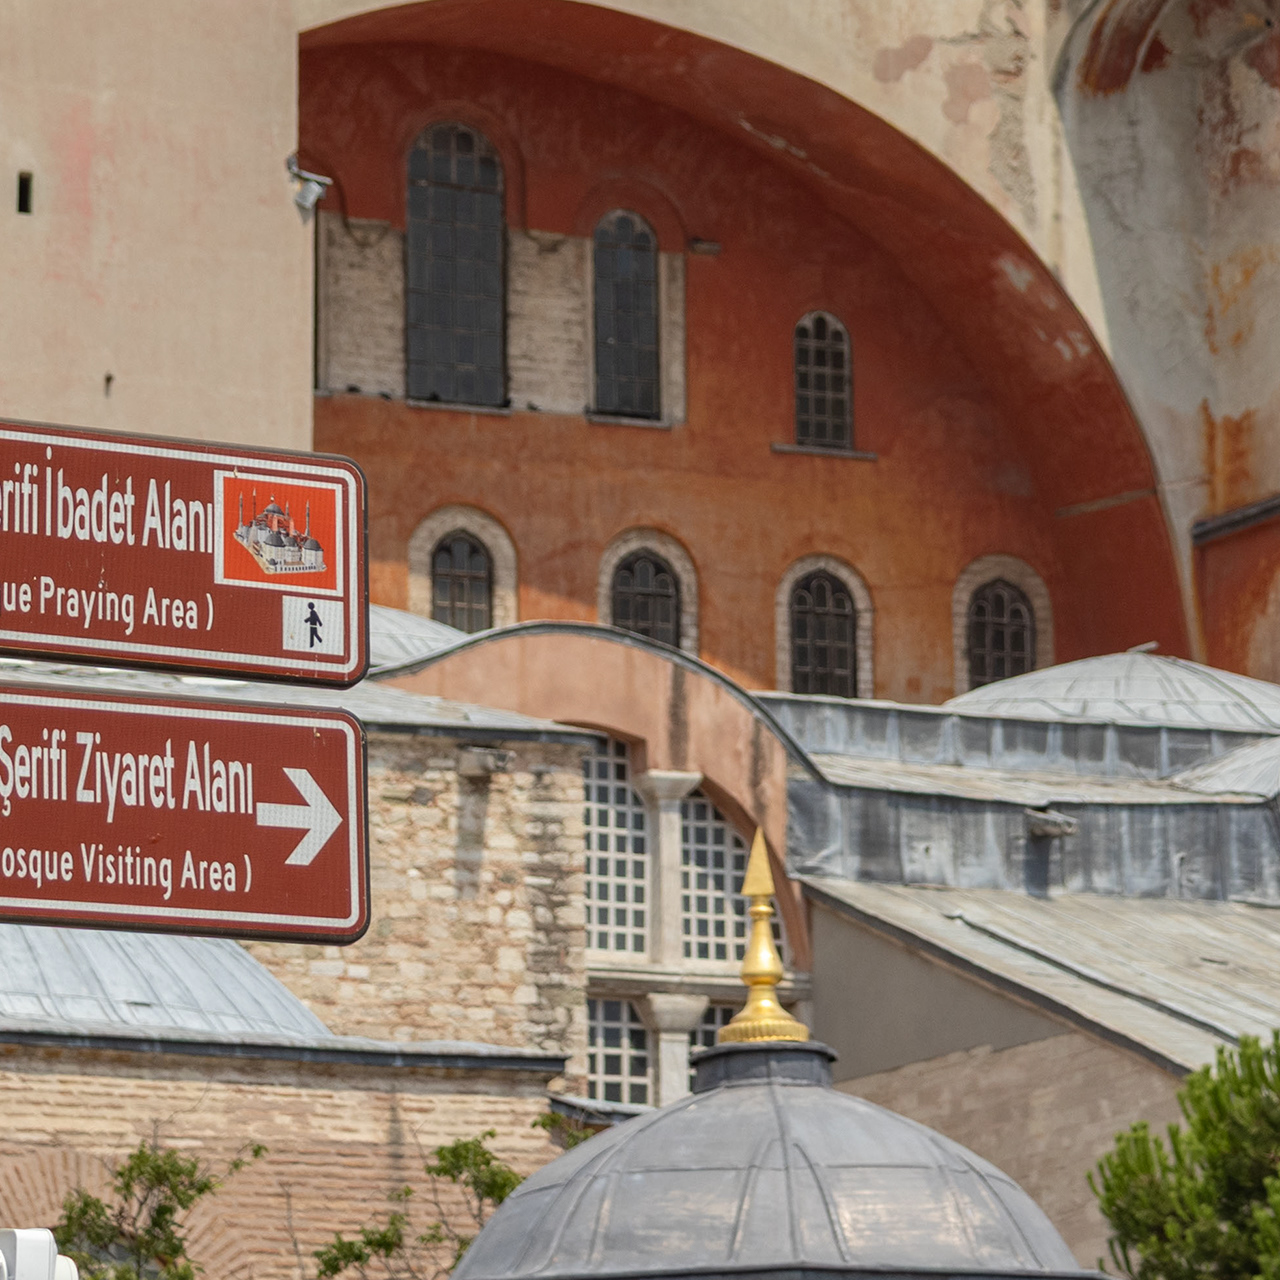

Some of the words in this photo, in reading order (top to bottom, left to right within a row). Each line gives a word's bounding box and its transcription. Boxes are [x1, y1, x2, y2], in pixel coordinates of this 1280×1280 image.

[45, 447, 135, 546] İbadet
[142, 478, 213, 554] Alanı
[40, 576, 134, 636] Praying
[76, 732, 175, 823] Ziyaret
[182, 740, 254, 814] Alanı
[81, 843, 173, 901] Visiting
